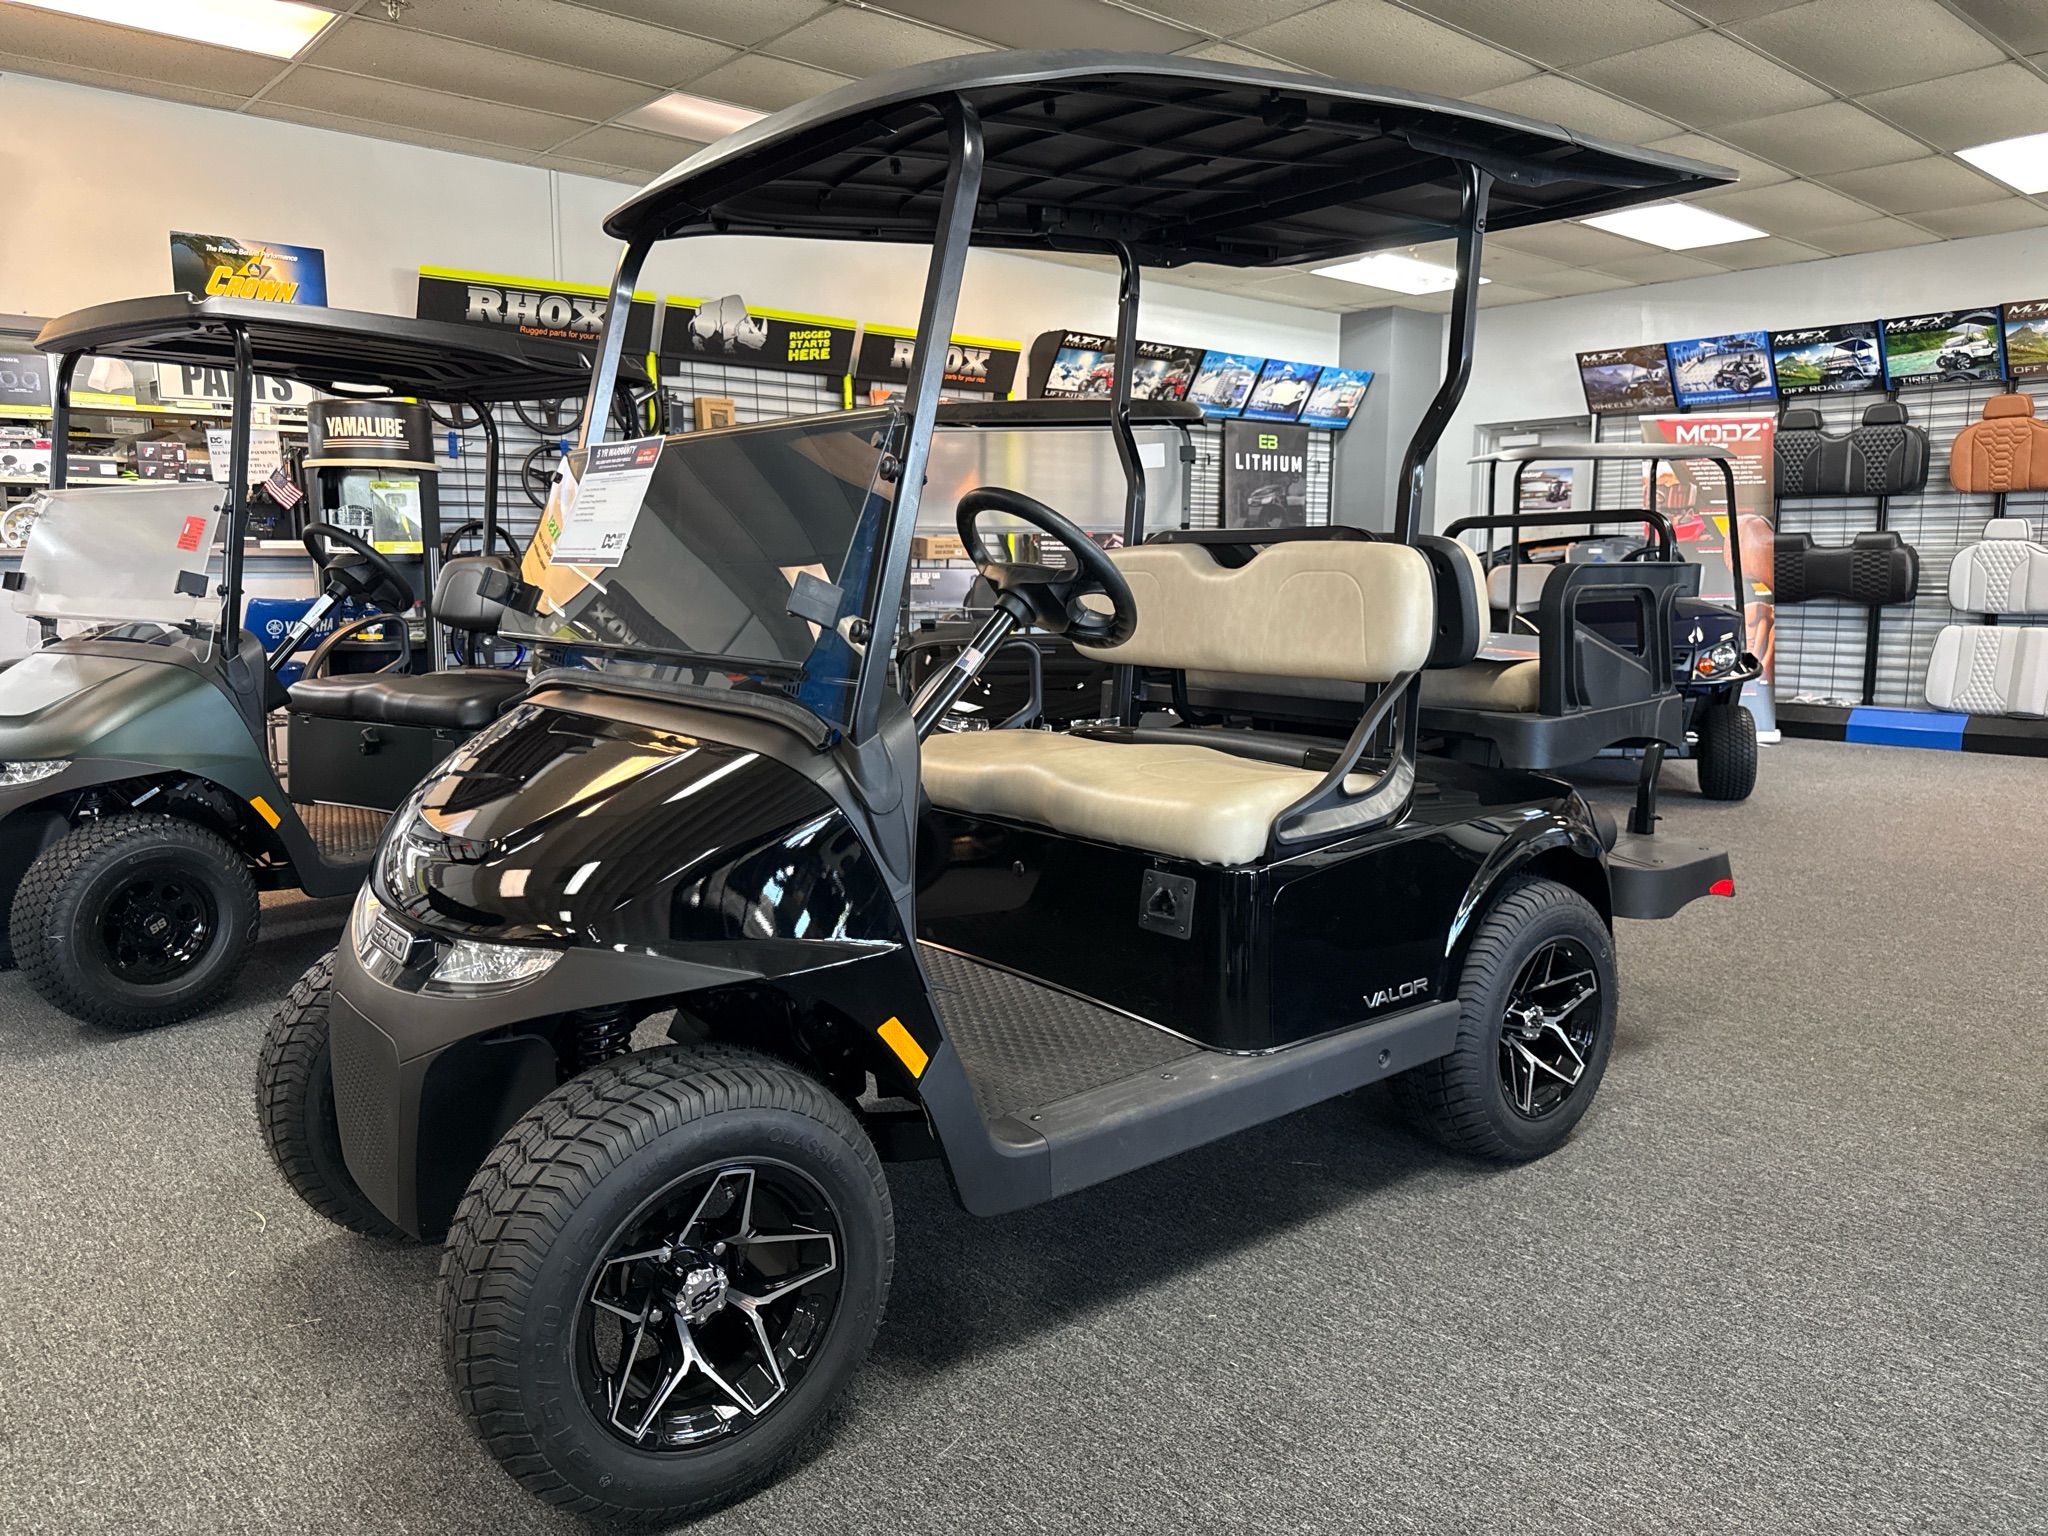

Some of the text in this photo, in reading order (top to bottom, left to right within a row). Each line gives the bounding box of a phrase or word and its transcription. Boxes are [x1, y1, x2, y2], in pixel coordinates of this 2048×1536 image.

[205, 244, 298, 262] The Power Behind Performance
[205, 265, 299, 303] CROWN
[465, 285, 607, 332] RHOX
[519, 325, 548, 336] Rugged
[549, 328, 567, 338] parts
[568, 329, 578, 338] for
[579, 331, 595, 341] your
[789, 330, 831, 340] RUGGED
[789, 339, 830, 349] STARTS
[788, 348, 830, 361] HERE
[890, 339, 992, 377] ROX
[2013, 365, 2041, 374] OFF
[1900, 375, 1939, 385] TIRES
[1065, 391, 1085, 399] KITS
[1782, 383, 1845, 395] OFF ROAD
[1592, 400, 1633, 411] WHEELS
[326, 416, 405, 438] YAMALUBE
[1676, 423, 1762, 443] MODZ
[210, 436, 222, 444] DC
[1235, 452, 1303, 473] LITHIUM
[150, 917, 167, 935] SS
[1363, 977, 1428, 1009] VALOR
